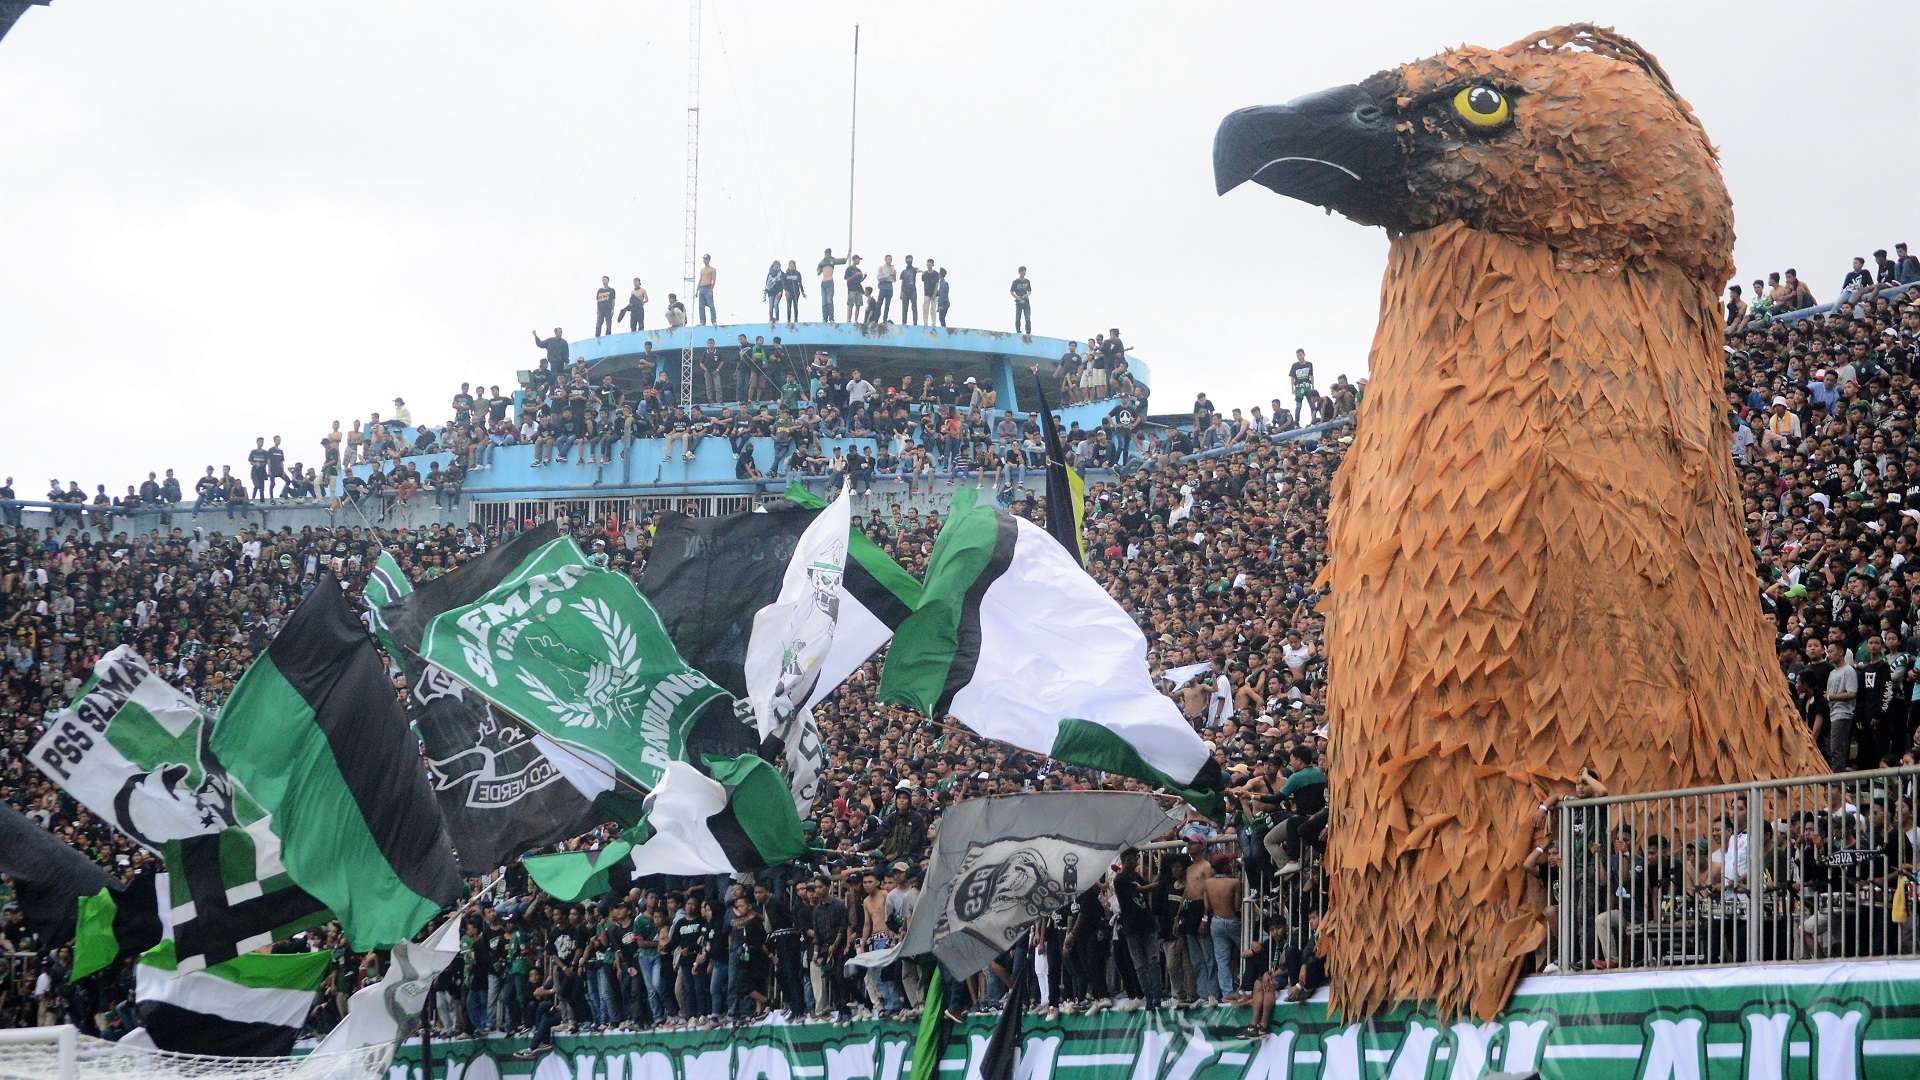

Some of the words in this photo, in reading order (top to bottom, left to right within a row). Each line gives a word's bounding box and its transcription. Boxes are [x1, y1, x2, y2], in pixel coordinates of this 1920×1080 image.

[41, 721, 94, 780] PSS
[78, 652, 148, 732] SLEMA
[640, 672, 708, 769] BANDUNG
